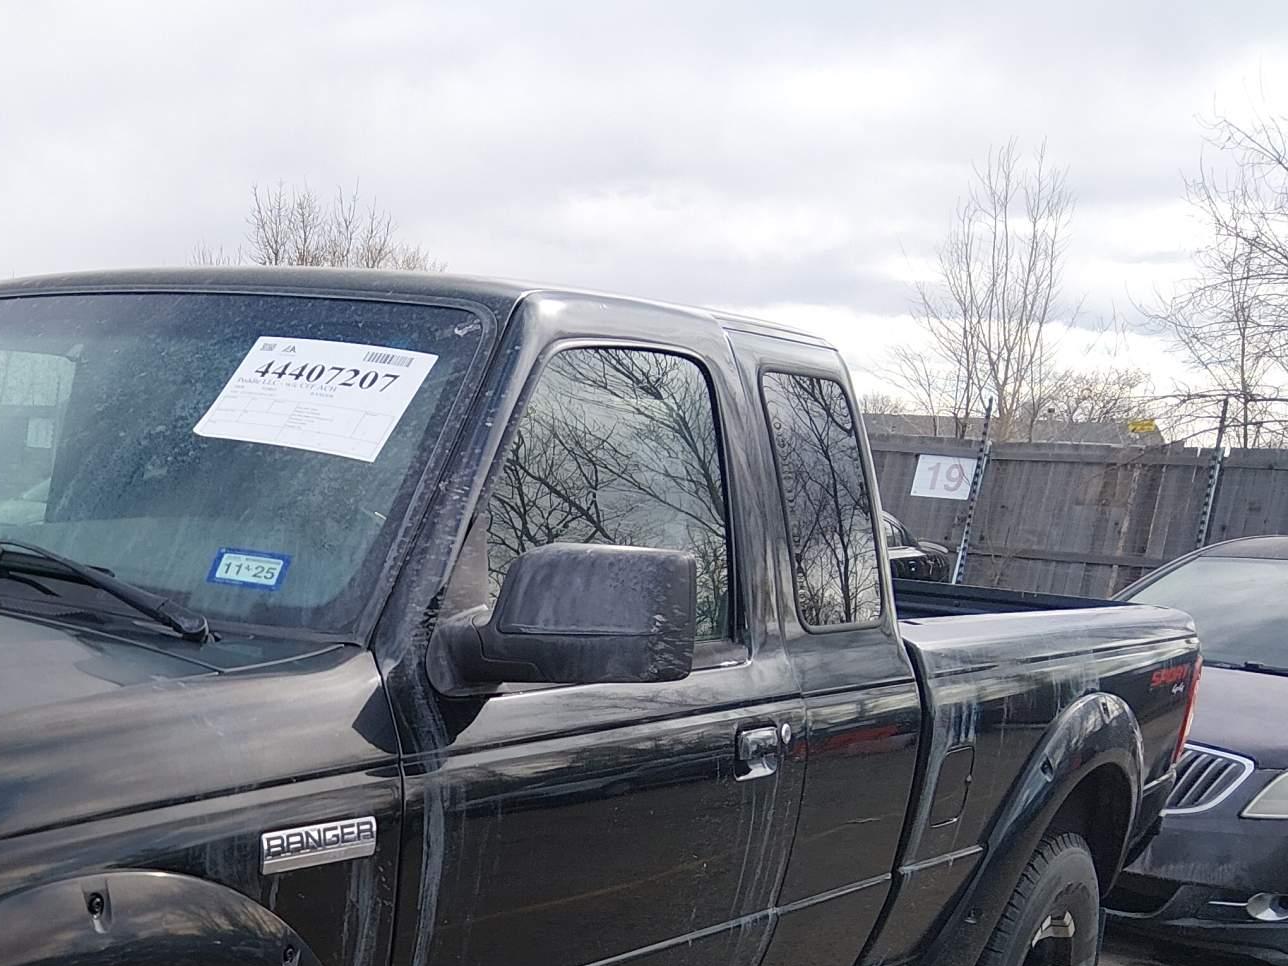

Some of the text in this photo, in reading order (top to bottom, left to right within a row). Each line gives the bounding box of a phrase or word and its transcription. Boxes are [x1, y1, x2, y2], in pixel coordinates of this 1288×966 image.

[254, 359, 400, 393] 44407207
[927, 462, 965, 492] 19
[252, 566, 277, 580] 25
[266, 821, 374, 857] RANGER
